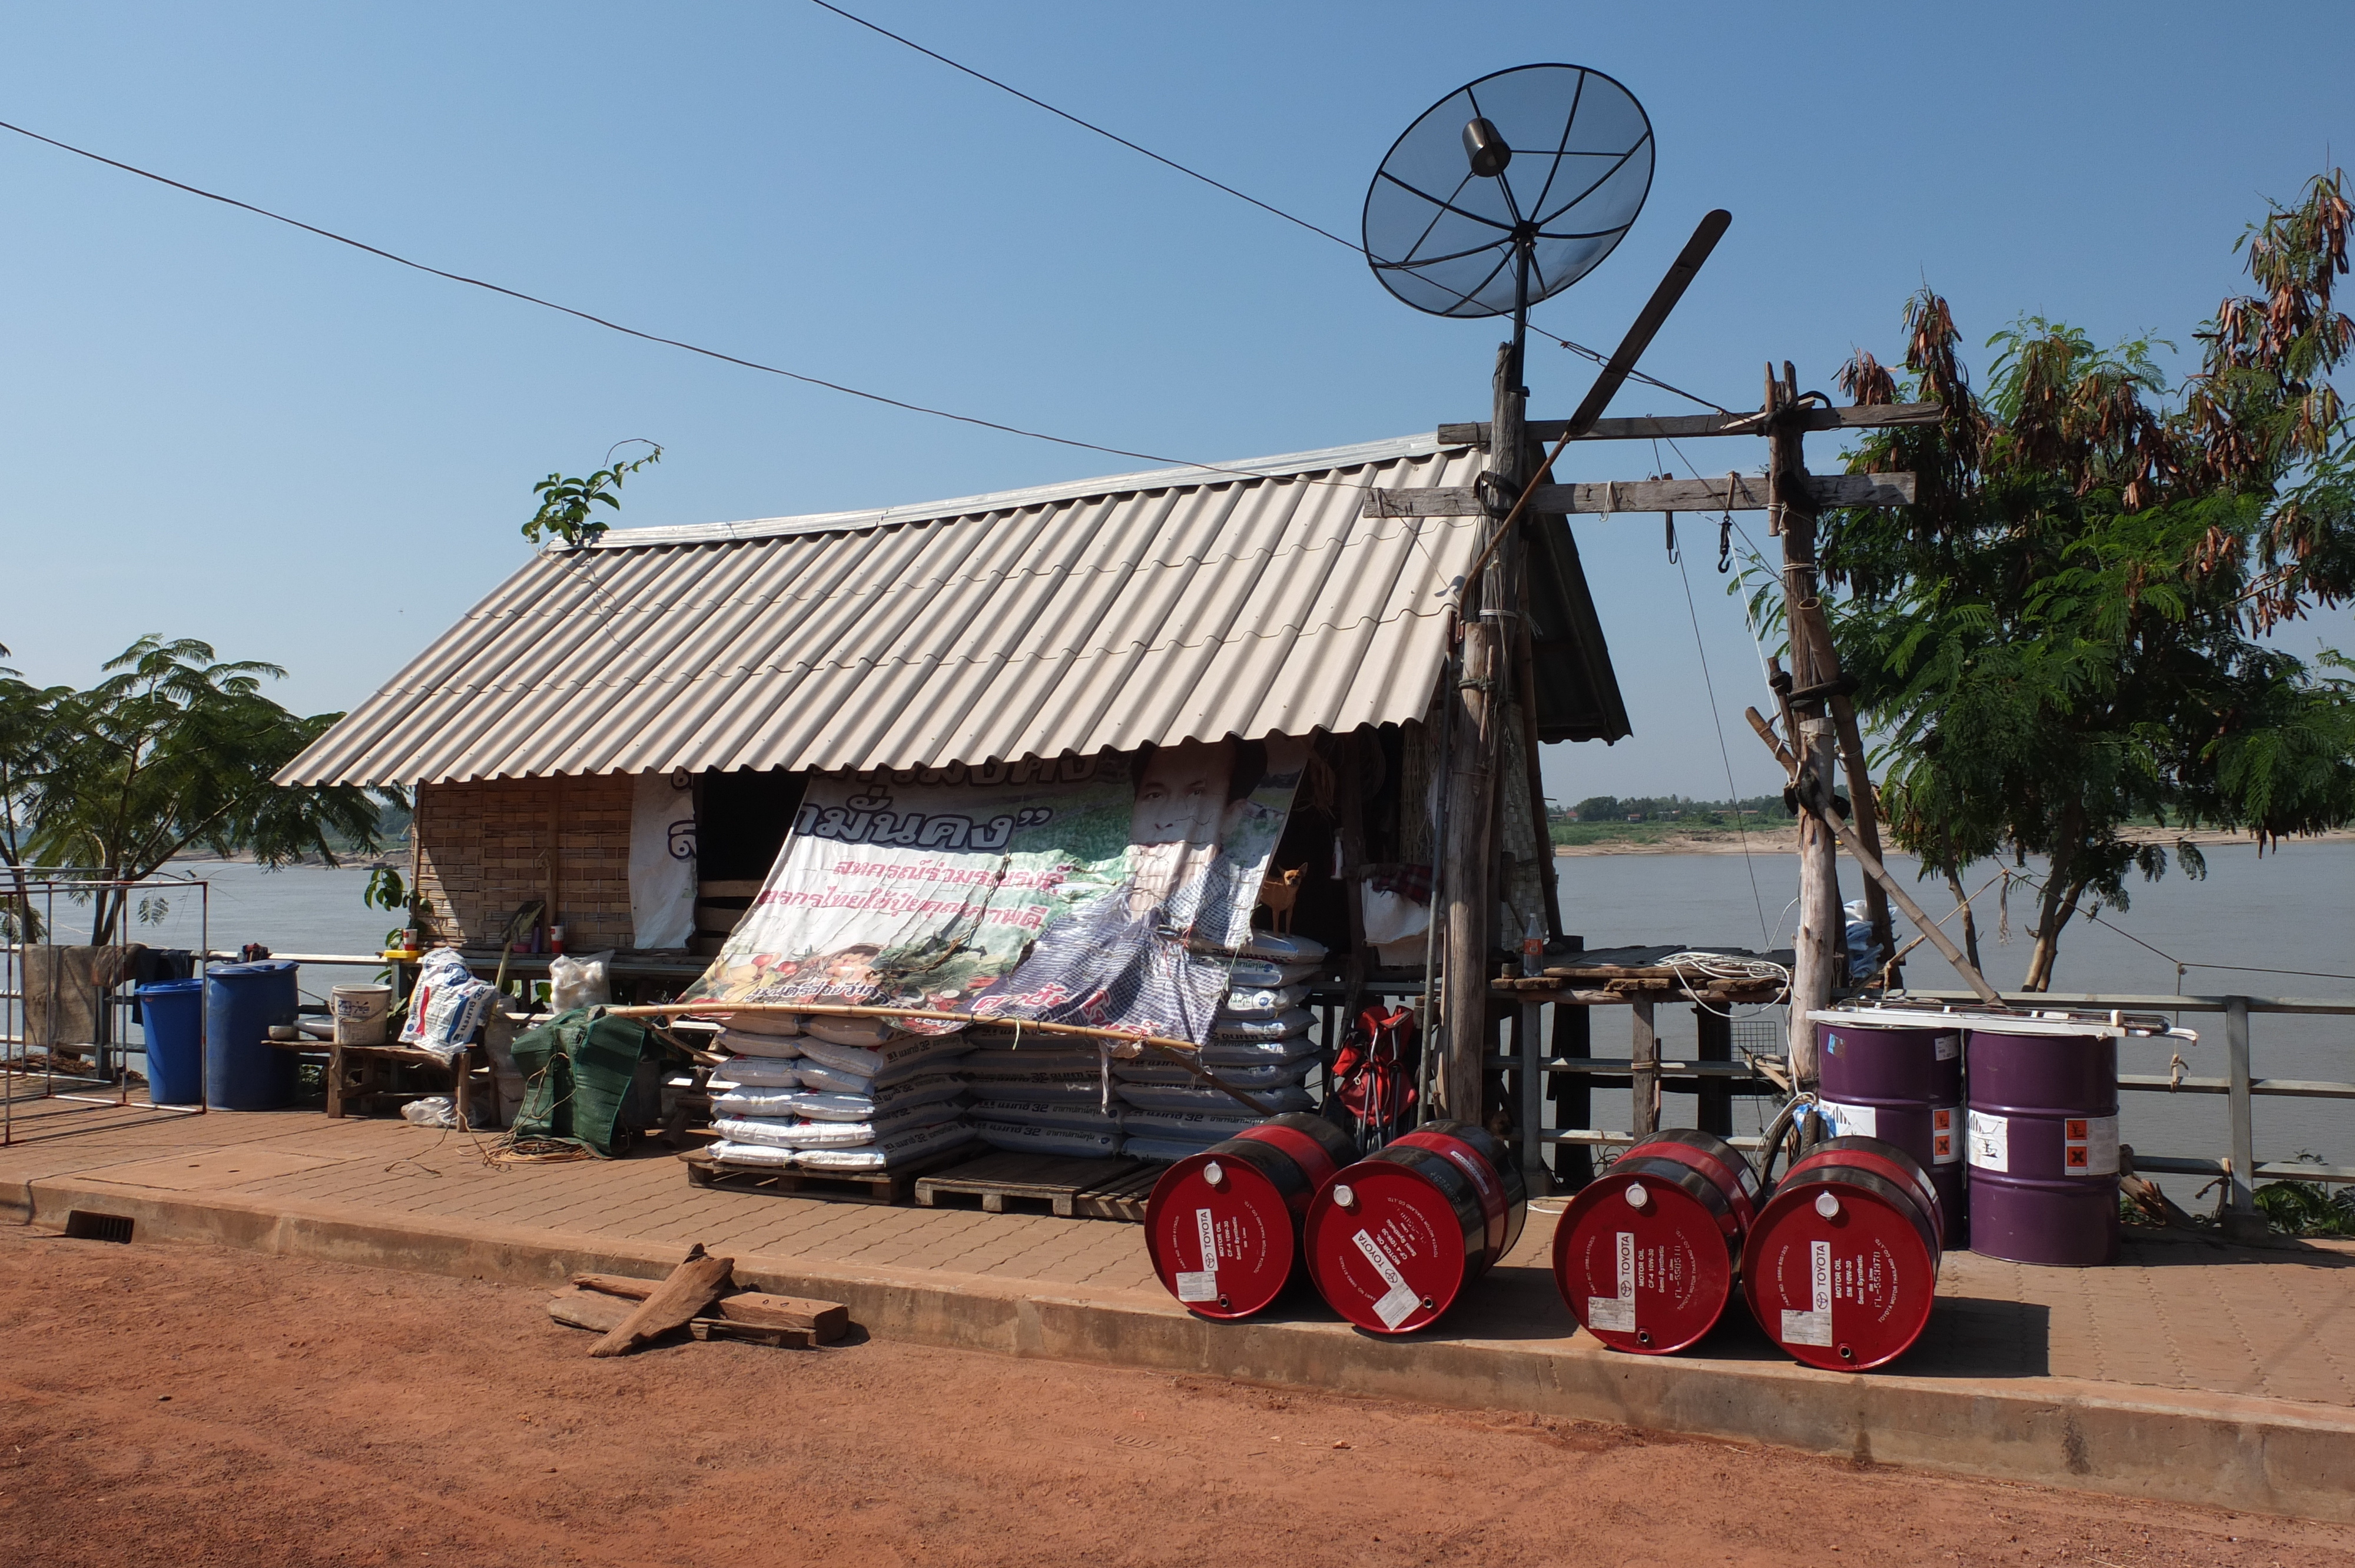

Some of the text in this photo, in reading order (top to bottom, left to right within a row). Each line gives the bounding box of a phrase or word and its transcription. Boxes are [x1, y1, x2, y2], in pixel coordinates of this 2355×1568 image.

[474, 987, 487, 1001] 32
[920, 1040, 930, 1051] 32
[1031, 1103, 1049, 1112] 32
[915, 1133, 928, 1143] 32
[1023, 1127, 1041, 1137] 32
[1200, 1211, 1211, 1249] TOYOTA
[1386, 1218, 1406, 1243] Synthetic
[1424, 1221, 1435, 1238] MOTOR
[1358, 1234, 1384, 1268] TOYOTA
[1376, 1234, 1401, 1265] MOTOR OIL
[1405, 1243, 1417, 1257] Semi
[1621, 1235, 1630, 1275] TOYOTA
[1253, 1258, 1263, 1274] TOYOTA
[1816, 1245, 1826, 1287] TOYOTA
[1677, 1294, 1691, 1311] TOYOTA
[1878, 1305, 1893, 1323] TOYOTA
[1890, 1285, 1898, 1305] MOTOR
